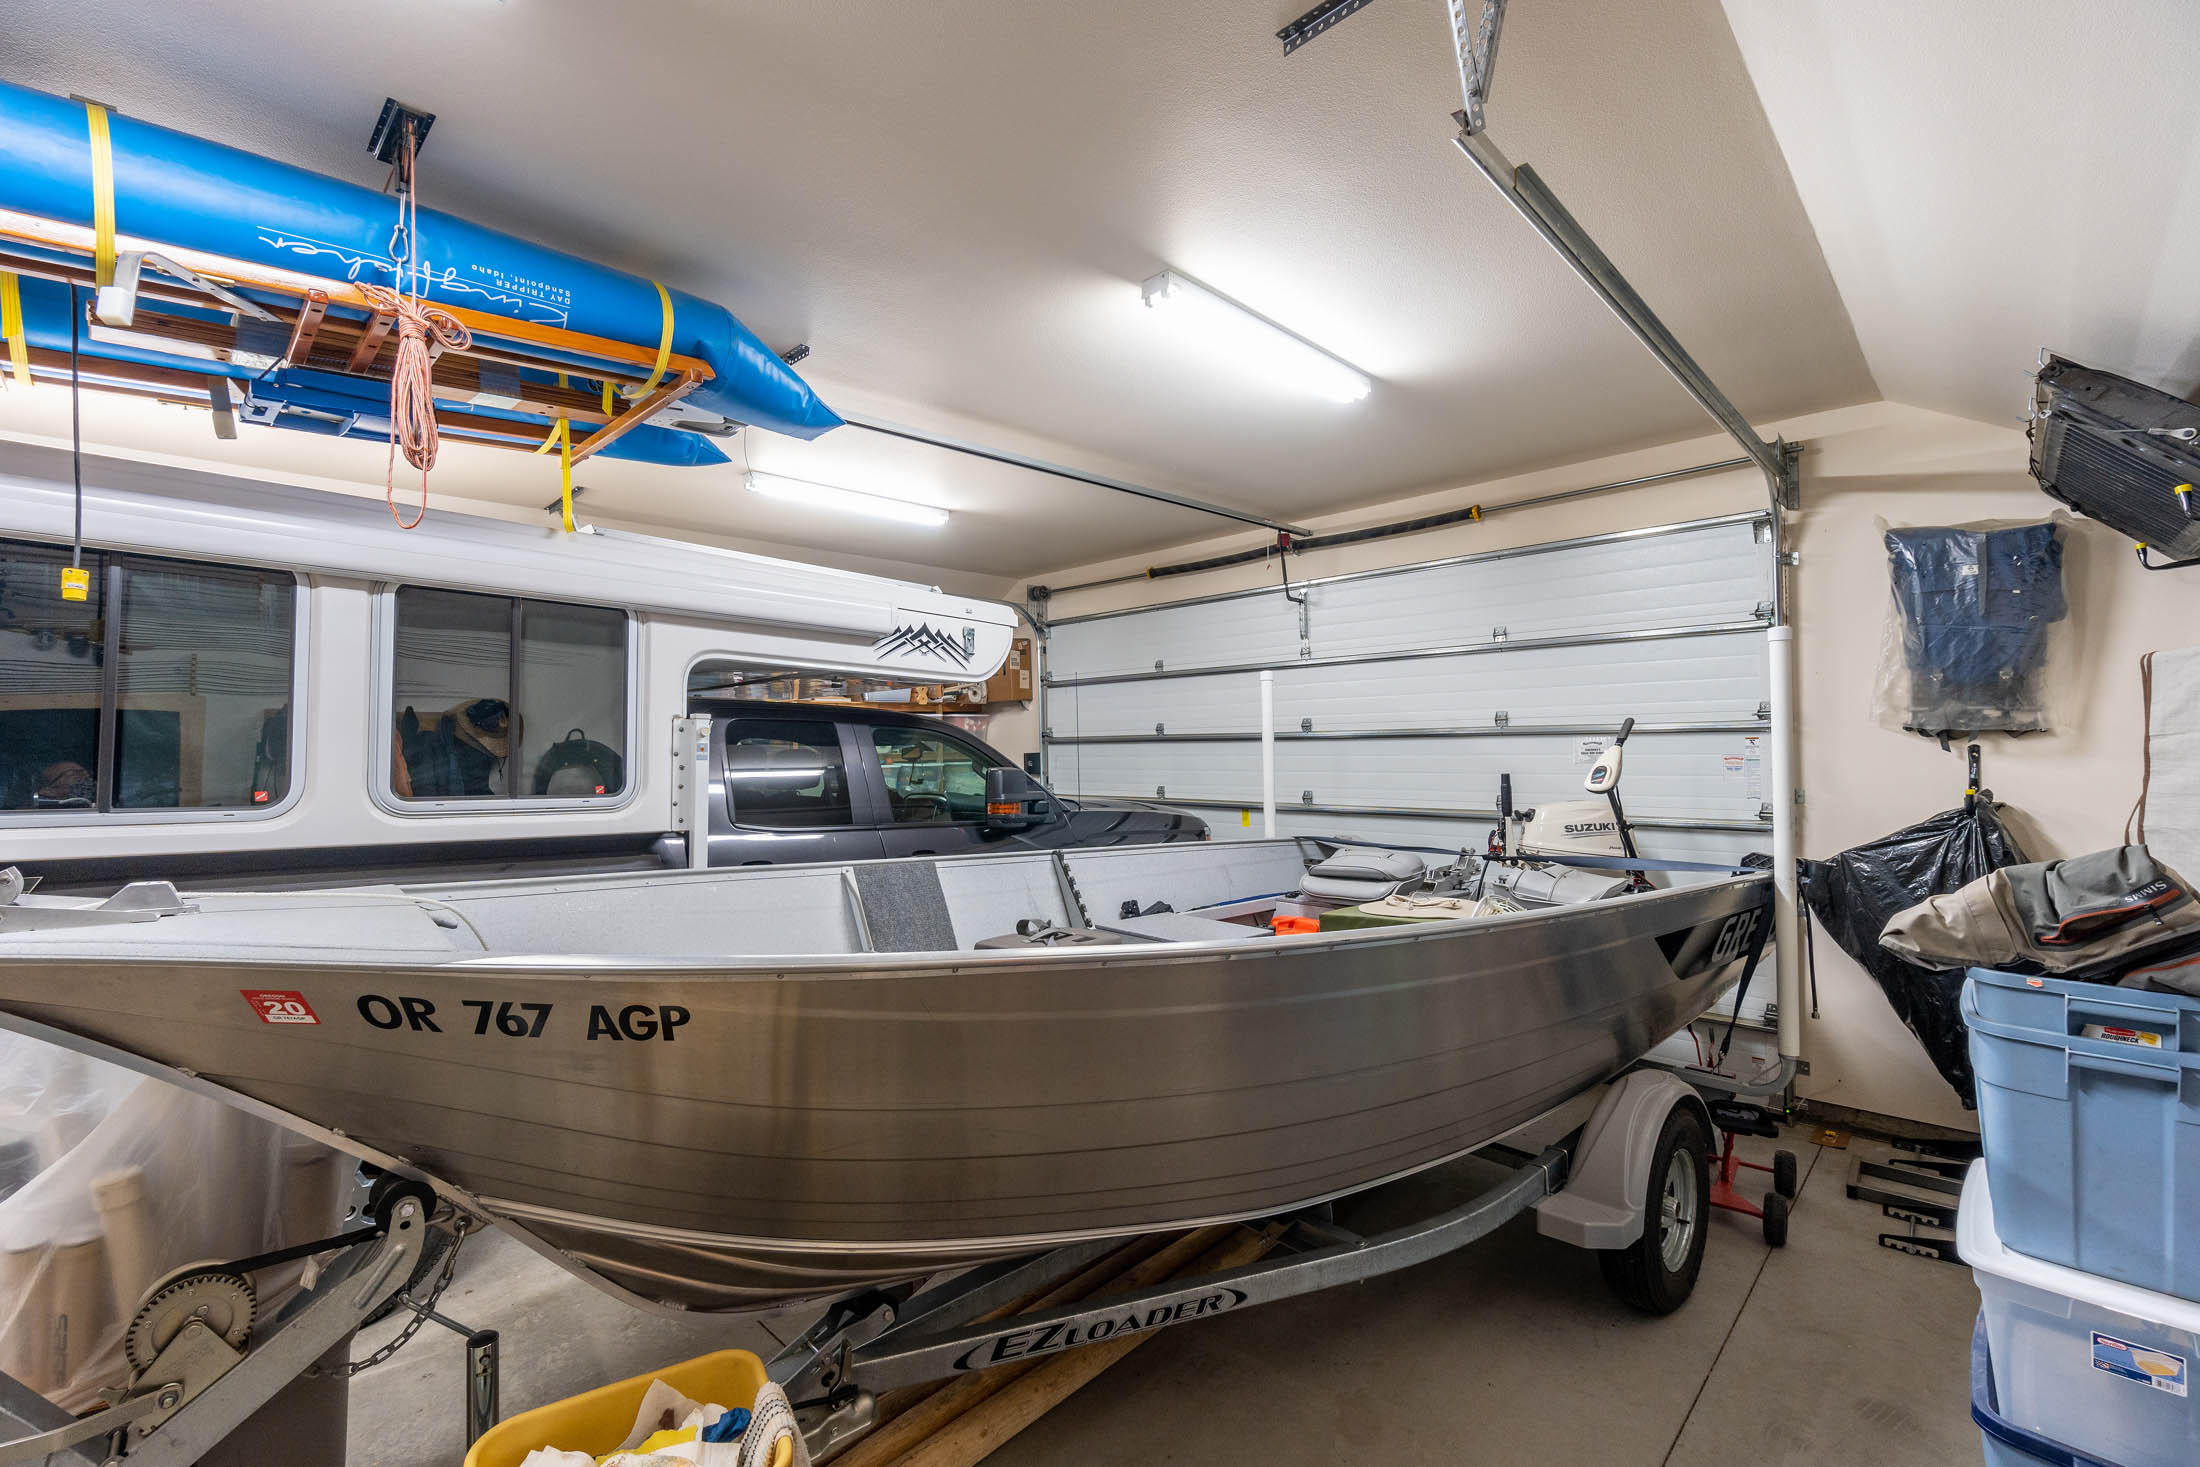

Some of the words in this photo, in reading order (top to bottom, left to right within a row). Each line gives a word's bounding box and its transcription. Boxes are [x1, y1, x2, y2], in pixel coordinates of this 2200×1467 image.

[472, 264, 504, 279] Idaho
[496, 279, 544, 298] TRIPPER
[510, 274, 570, 297] Sandpoint,
[551, 293, 570, 305] DAY
[1564, 822, 1616, 833] SUZUKI
[2124, 880, 2168, 903] SIMMS
[1712, 907, 1776, 962] GRE
[263, 1001, 306, 1015] 20
[356, 994, 443, 1033] OR
[461, 999, 553, 1038] 767
[586, 1004, 691, 1041] AGP
